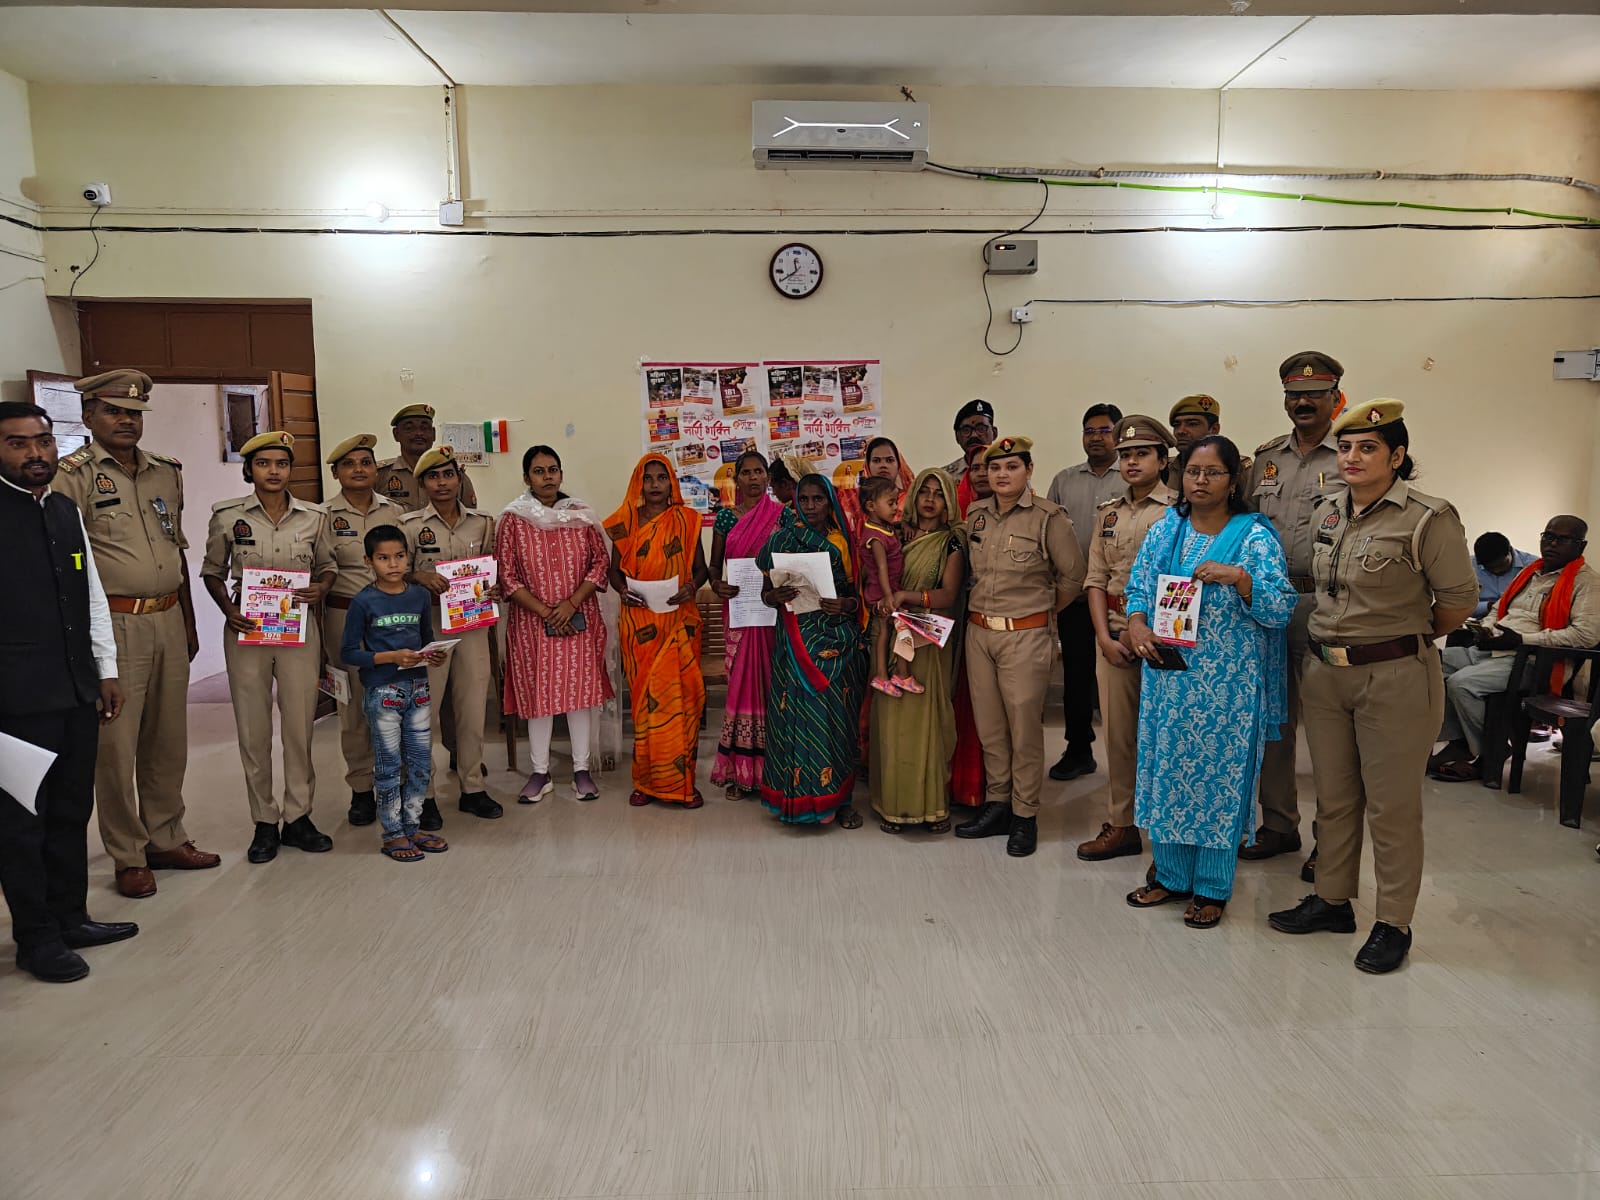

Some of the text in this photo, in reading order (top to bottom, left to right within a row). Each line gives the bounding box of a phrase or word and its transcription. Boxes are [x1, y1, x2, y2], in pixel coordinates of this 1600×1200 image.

[683, 420, 704, 441] नारी
[803, 417, 824, 439] नारी
[377, 615, 419, 626] SMOOTH
[396, 688, 406, 699] 5
